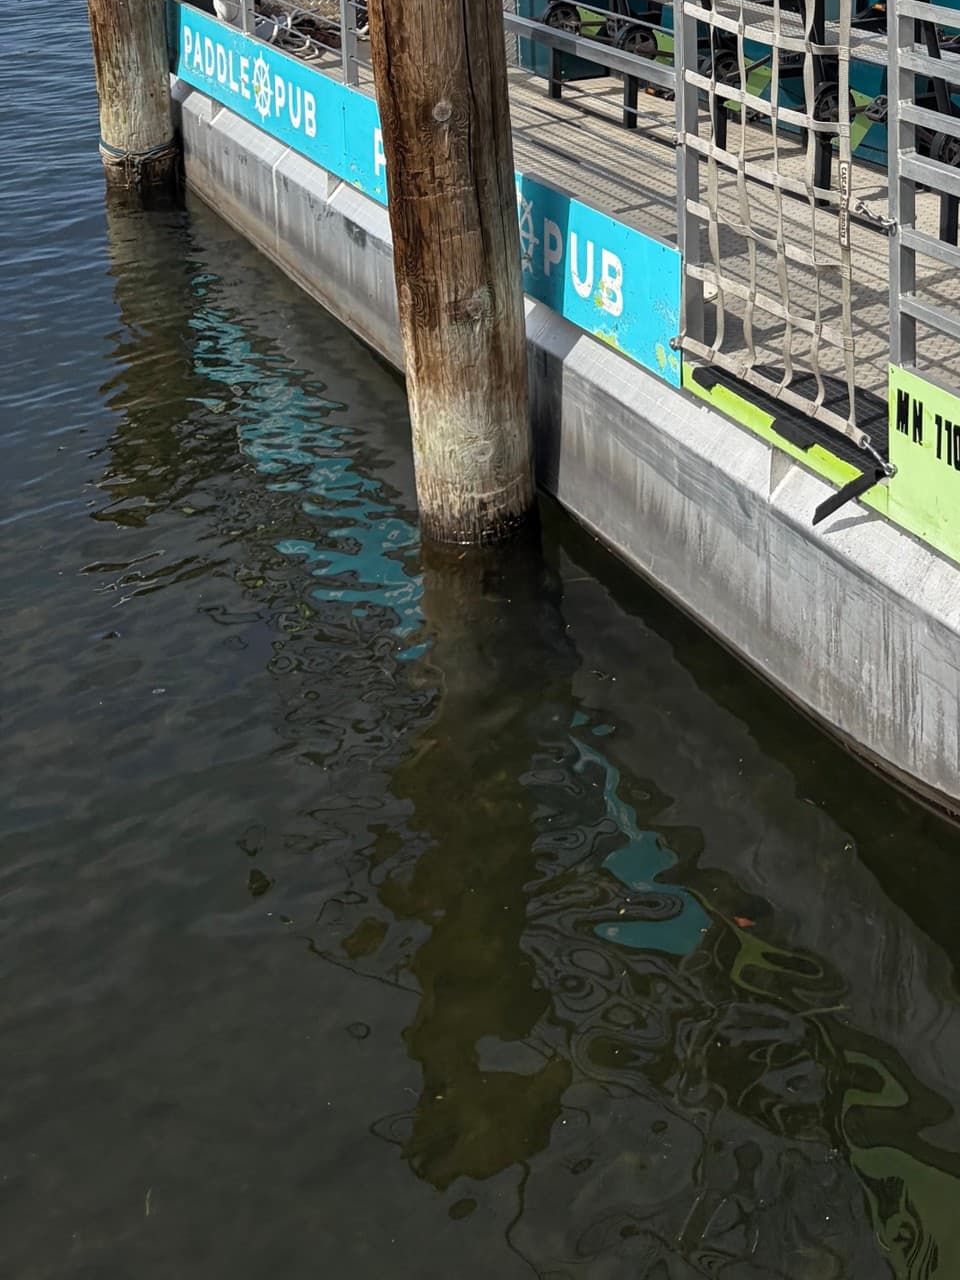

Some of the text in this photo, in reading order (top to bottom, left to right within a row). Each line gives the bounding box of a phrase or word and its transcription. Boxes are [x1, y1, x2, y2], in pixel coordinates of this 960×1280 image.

[183, 25, 317, 138] PADDLE PUB
[543, 217, 623, 317] PUB
[896, 388, 923, 446] MN
